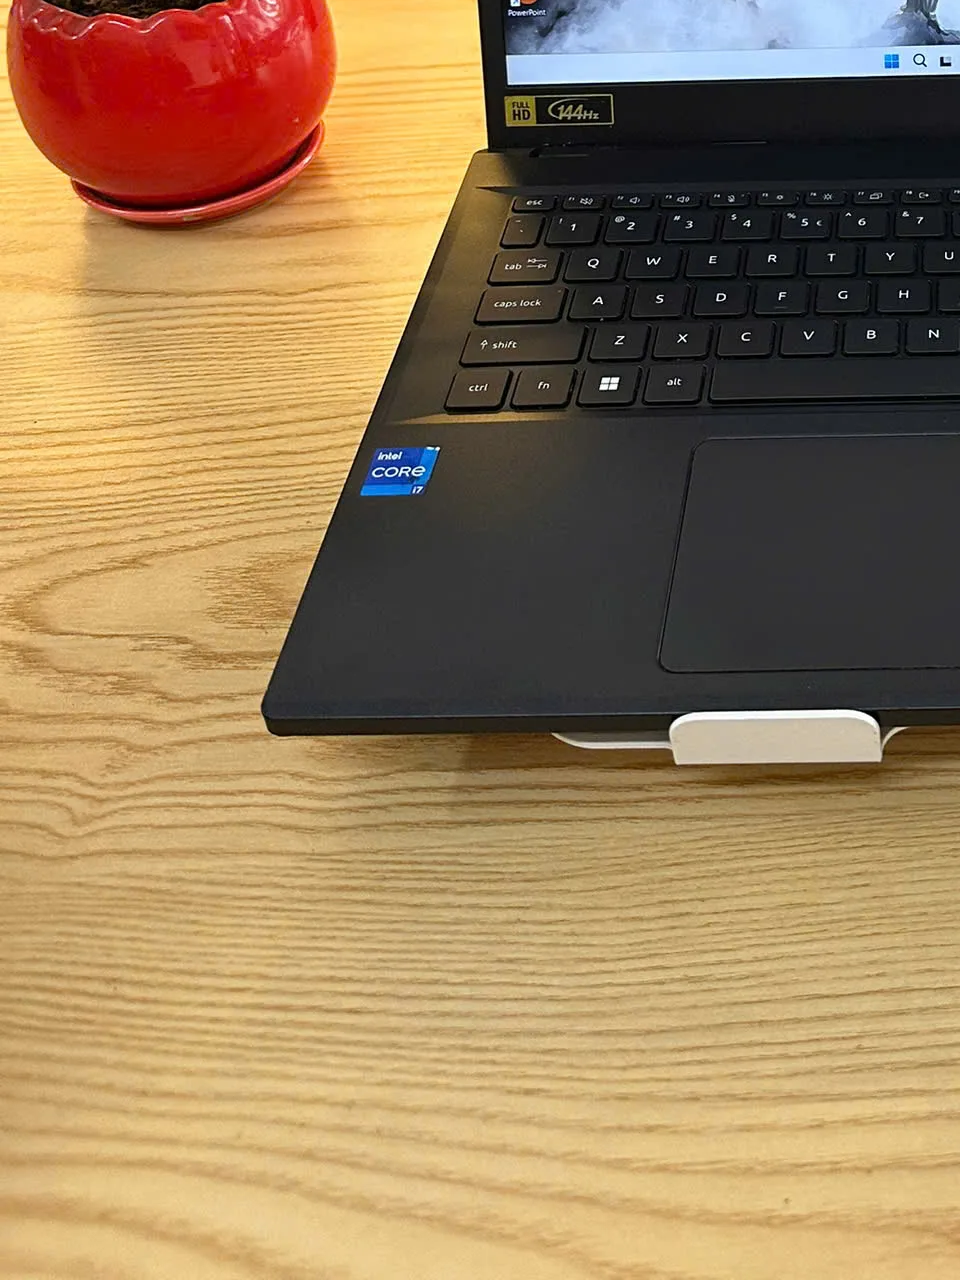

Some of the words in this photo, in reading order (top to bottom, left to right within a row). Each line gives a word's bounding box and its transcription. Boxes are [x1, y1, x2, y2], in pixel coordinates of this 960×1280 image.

[508, 9, 546, 17] PowerPoint
[513, 110, 530, 120] HD
[627, 222, 636, 230] 2
[685, 220, 693, 229] 3
[801, 218, 809, 226] 5
[858, 218, 866, 226] 6
[708, 255, 717, 264] E
[767, 254, 777, 263] R
[827, 253, 836, 262] T
[886, 252, 895, 261] Y
[944, 251, 954, 260] U
[587, 258, 599, 268] Q
[646, 256, 662, 266] W
[505, 262, 522, 270] tab
[655, 294, 664, 304] S
[716, 293, 727, 302] D
[778, 292, 787, 301] F
[838, 290, 849, 299] G
[899, 290, 909, 299] H
[494, 300, 517, 308] caps
[520, 299, 541, 307] lock
[592, 296, 604, 305] A
[677, 334, 688, 343] X
[741, 332, 751, 342] C
[804, 331, 815, 340] V
[866, 330, 877, 339] B
[928, 329, 940, 339] N
[492, 340, 517, 349] shift
[614, 336, 625, 345] Z
[538, 381, 550, 390] fn
[666, 378, 681, 386] alt
[468, 383, 488, 392] ctrl
[378, 452, 402, 460] intel
[412, 486, 423, 494] i7
